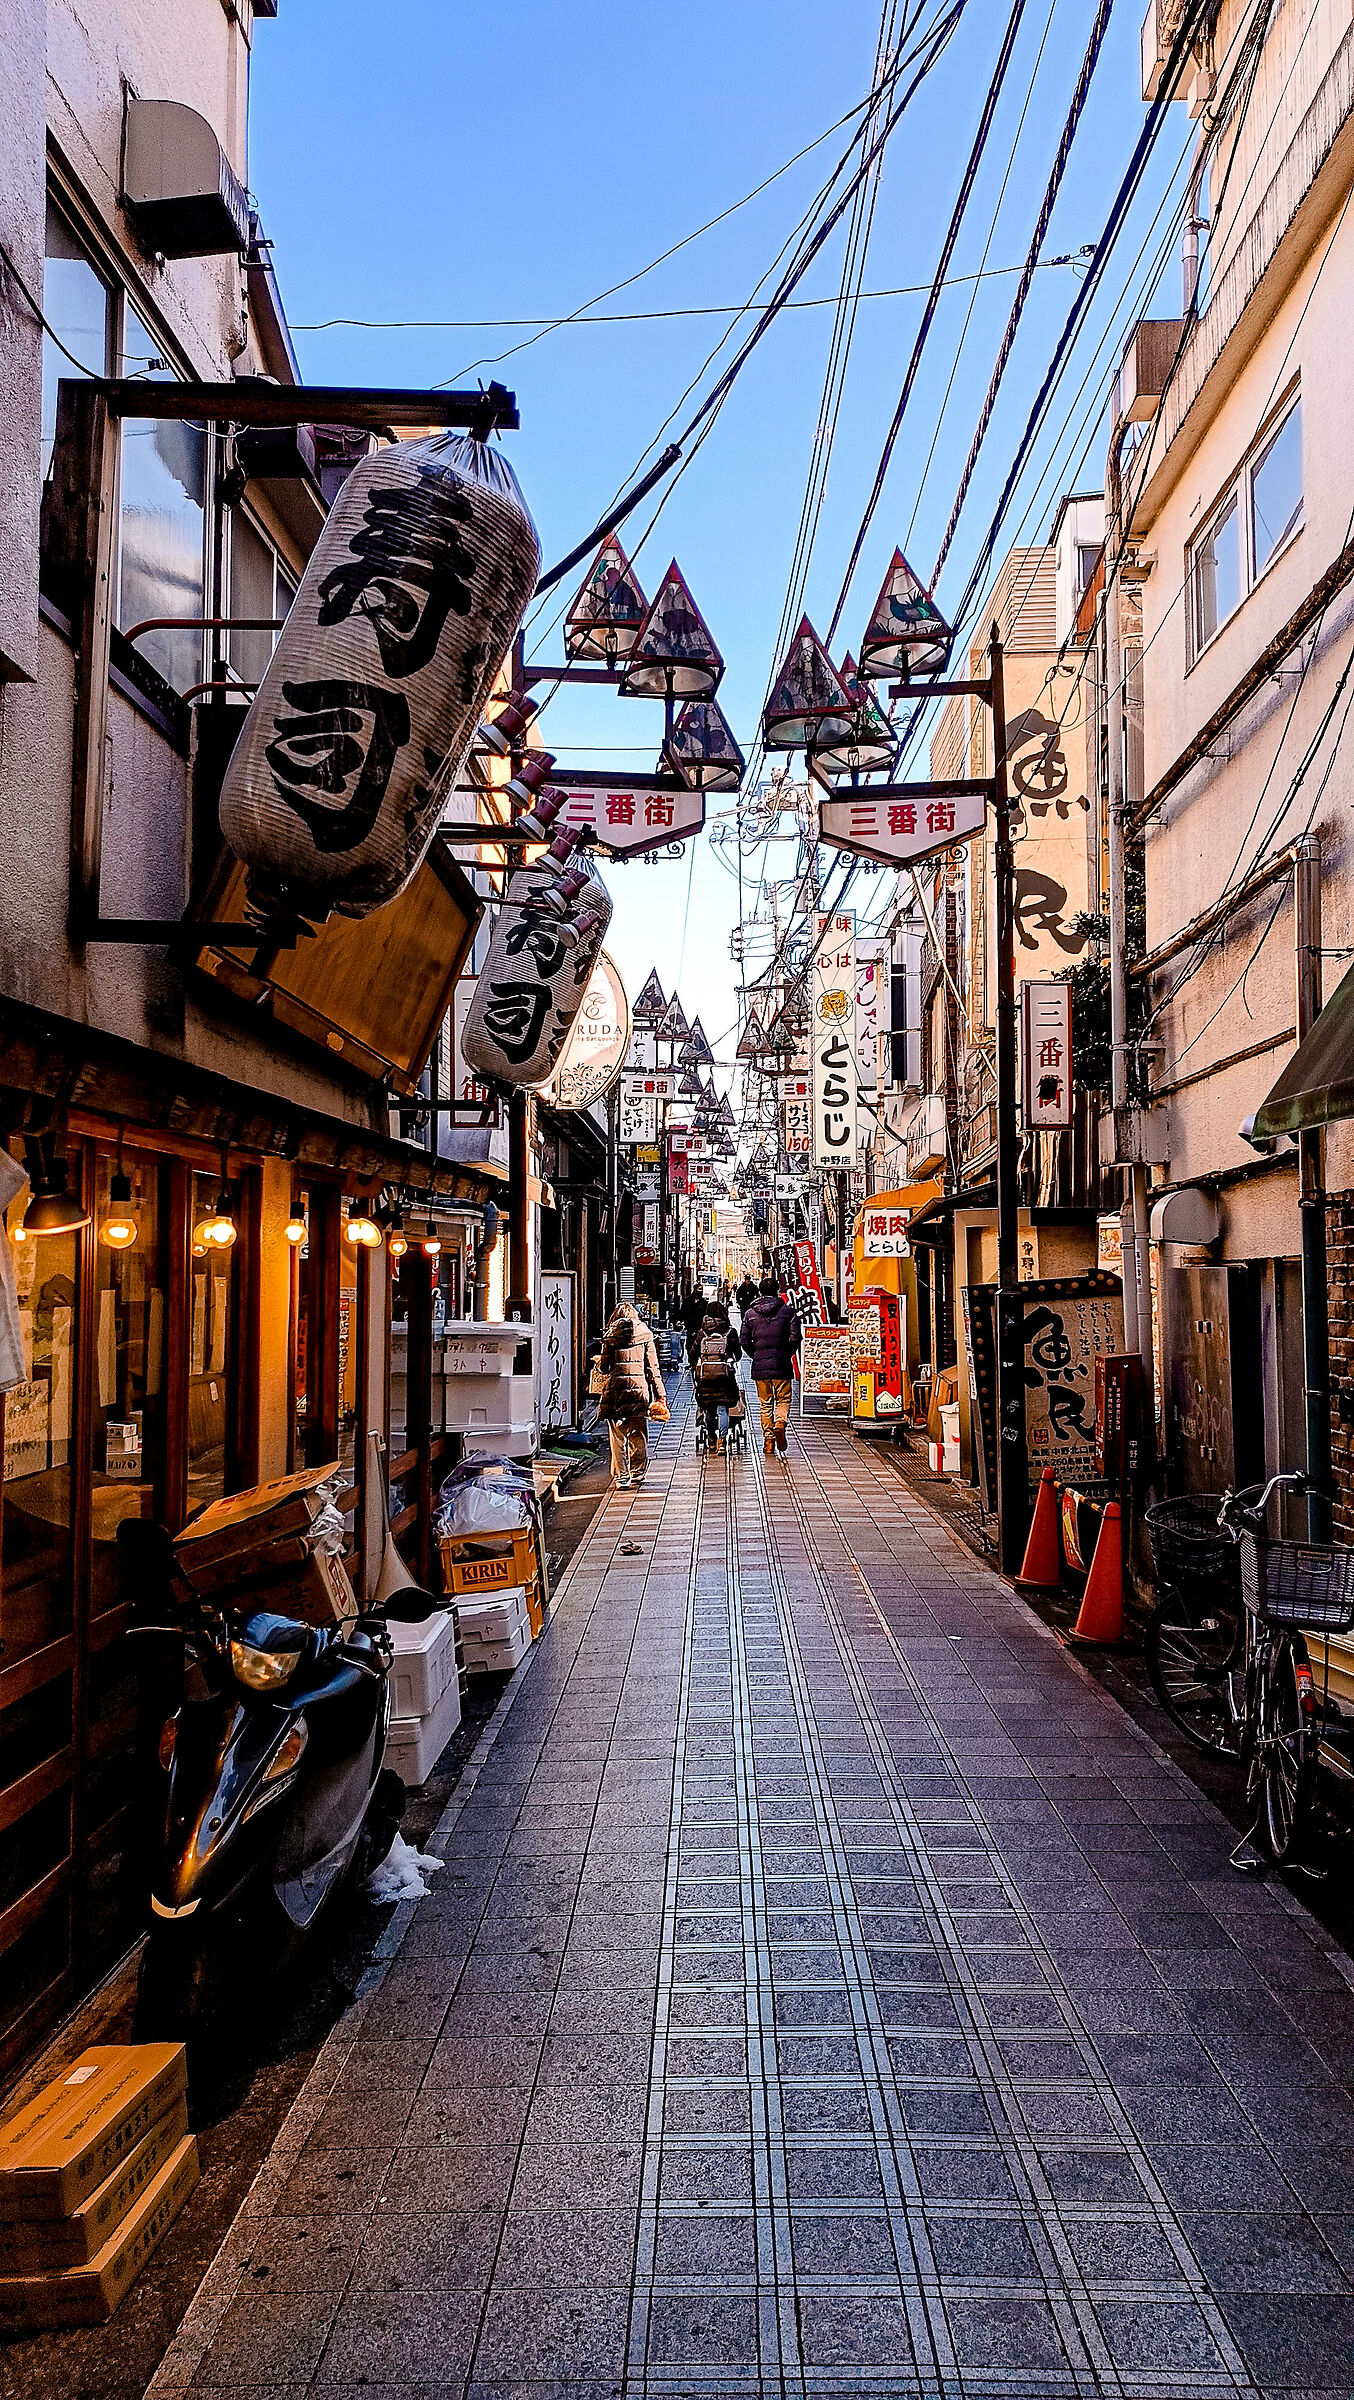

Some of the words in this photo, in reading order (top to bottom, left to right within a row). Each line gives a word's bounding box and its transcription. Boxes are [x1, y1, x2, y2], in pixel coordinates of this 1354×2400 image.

[265, 463, 477, 853] 寿司
[566, 793, 674, 826] 三番街
[849, 802, 956, 836] 三番街
[1006, 709, 1090, 954] 魚民
[483, 884, 581, 1064] 寿司
[632, 1081, 667, 1093] 三番街
[821, 1036, 850, 1146] とらじ
[788, 1137, 809, 1151] 150
[821, 1156, 851, 1165] 中野店
[868, 1215, 907, 1236] 焼肉
[869, 1241, 907, 1253] とらじ
[788, 1248, 798, 1285] スタミナ
[1023, 1305, 1095, 1441] 魚民
[461, 1562, 507, 1580] KIRIN
